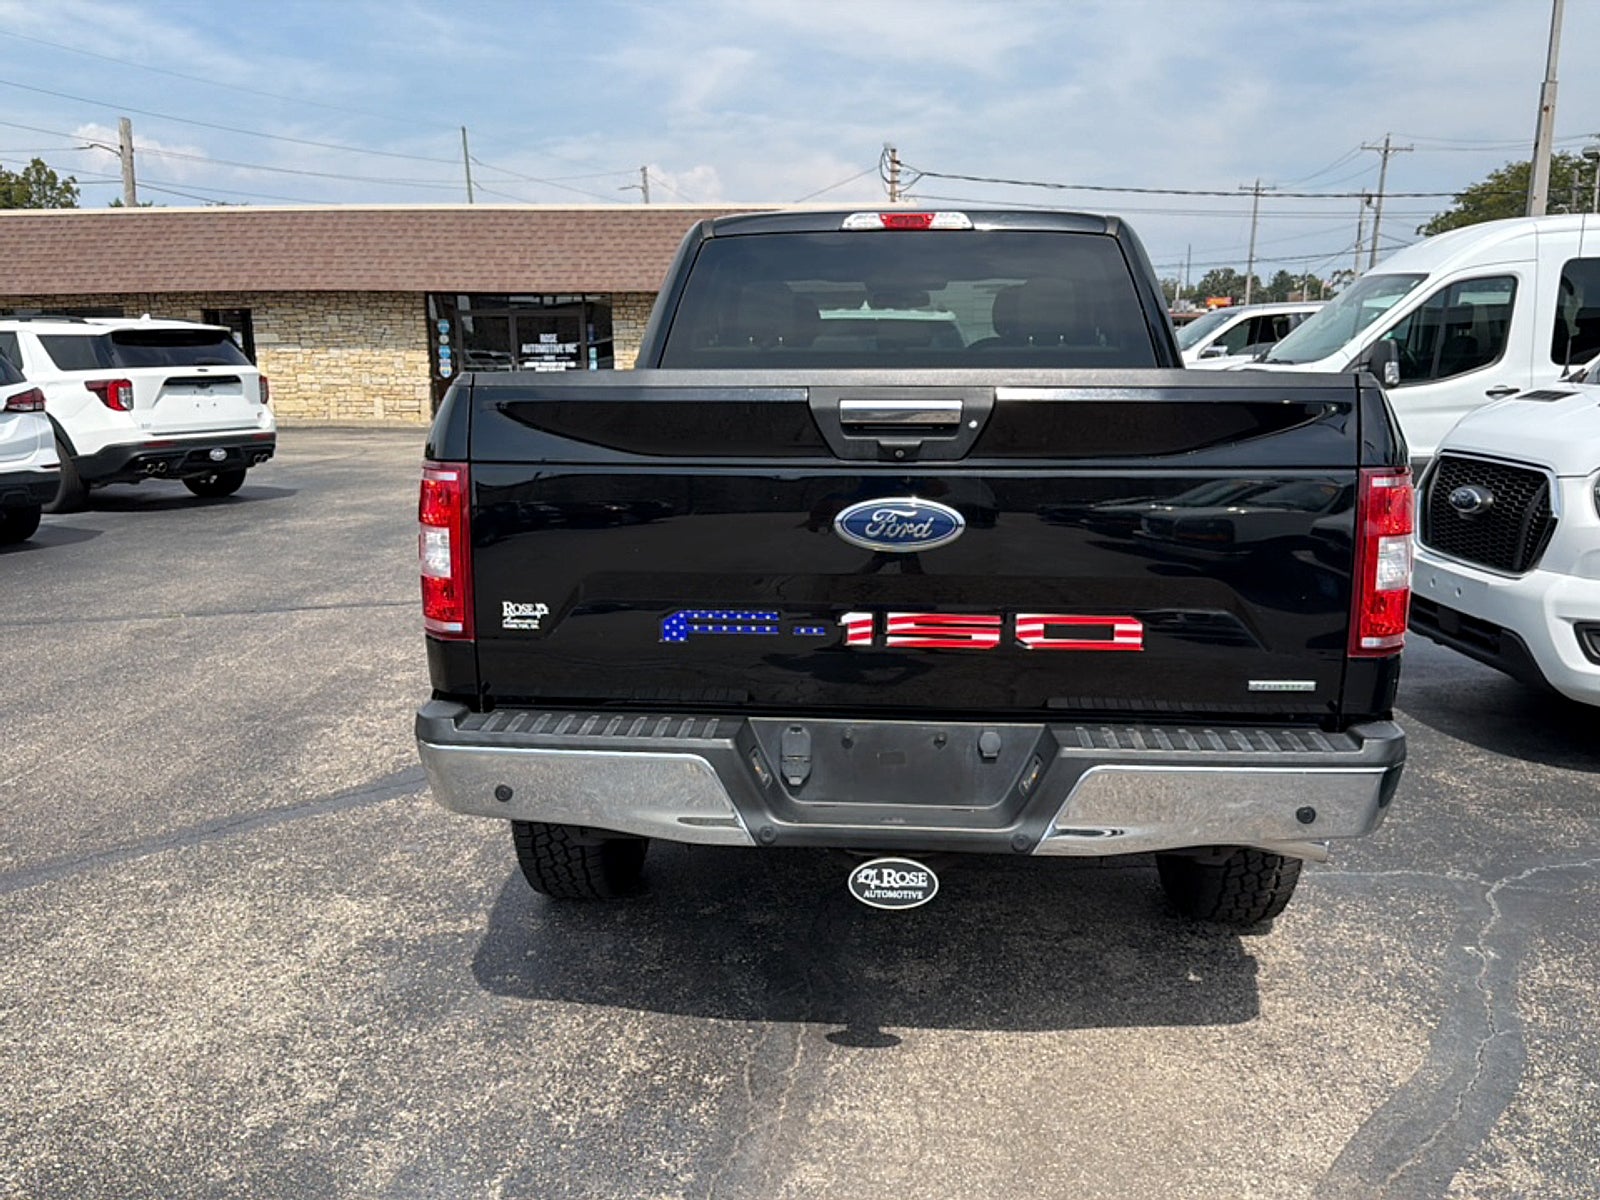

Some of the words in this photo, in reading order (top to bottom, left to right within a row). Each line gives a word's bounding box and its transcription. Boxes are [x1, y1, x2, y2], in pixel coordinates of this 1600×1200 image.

[865, 508, 935, 538] Ford
[659, 609, 1144, 651] F-150
[881, 868, 928, 888] ROSE
[863, 889, 924, 900] AUTOMOTIVE
